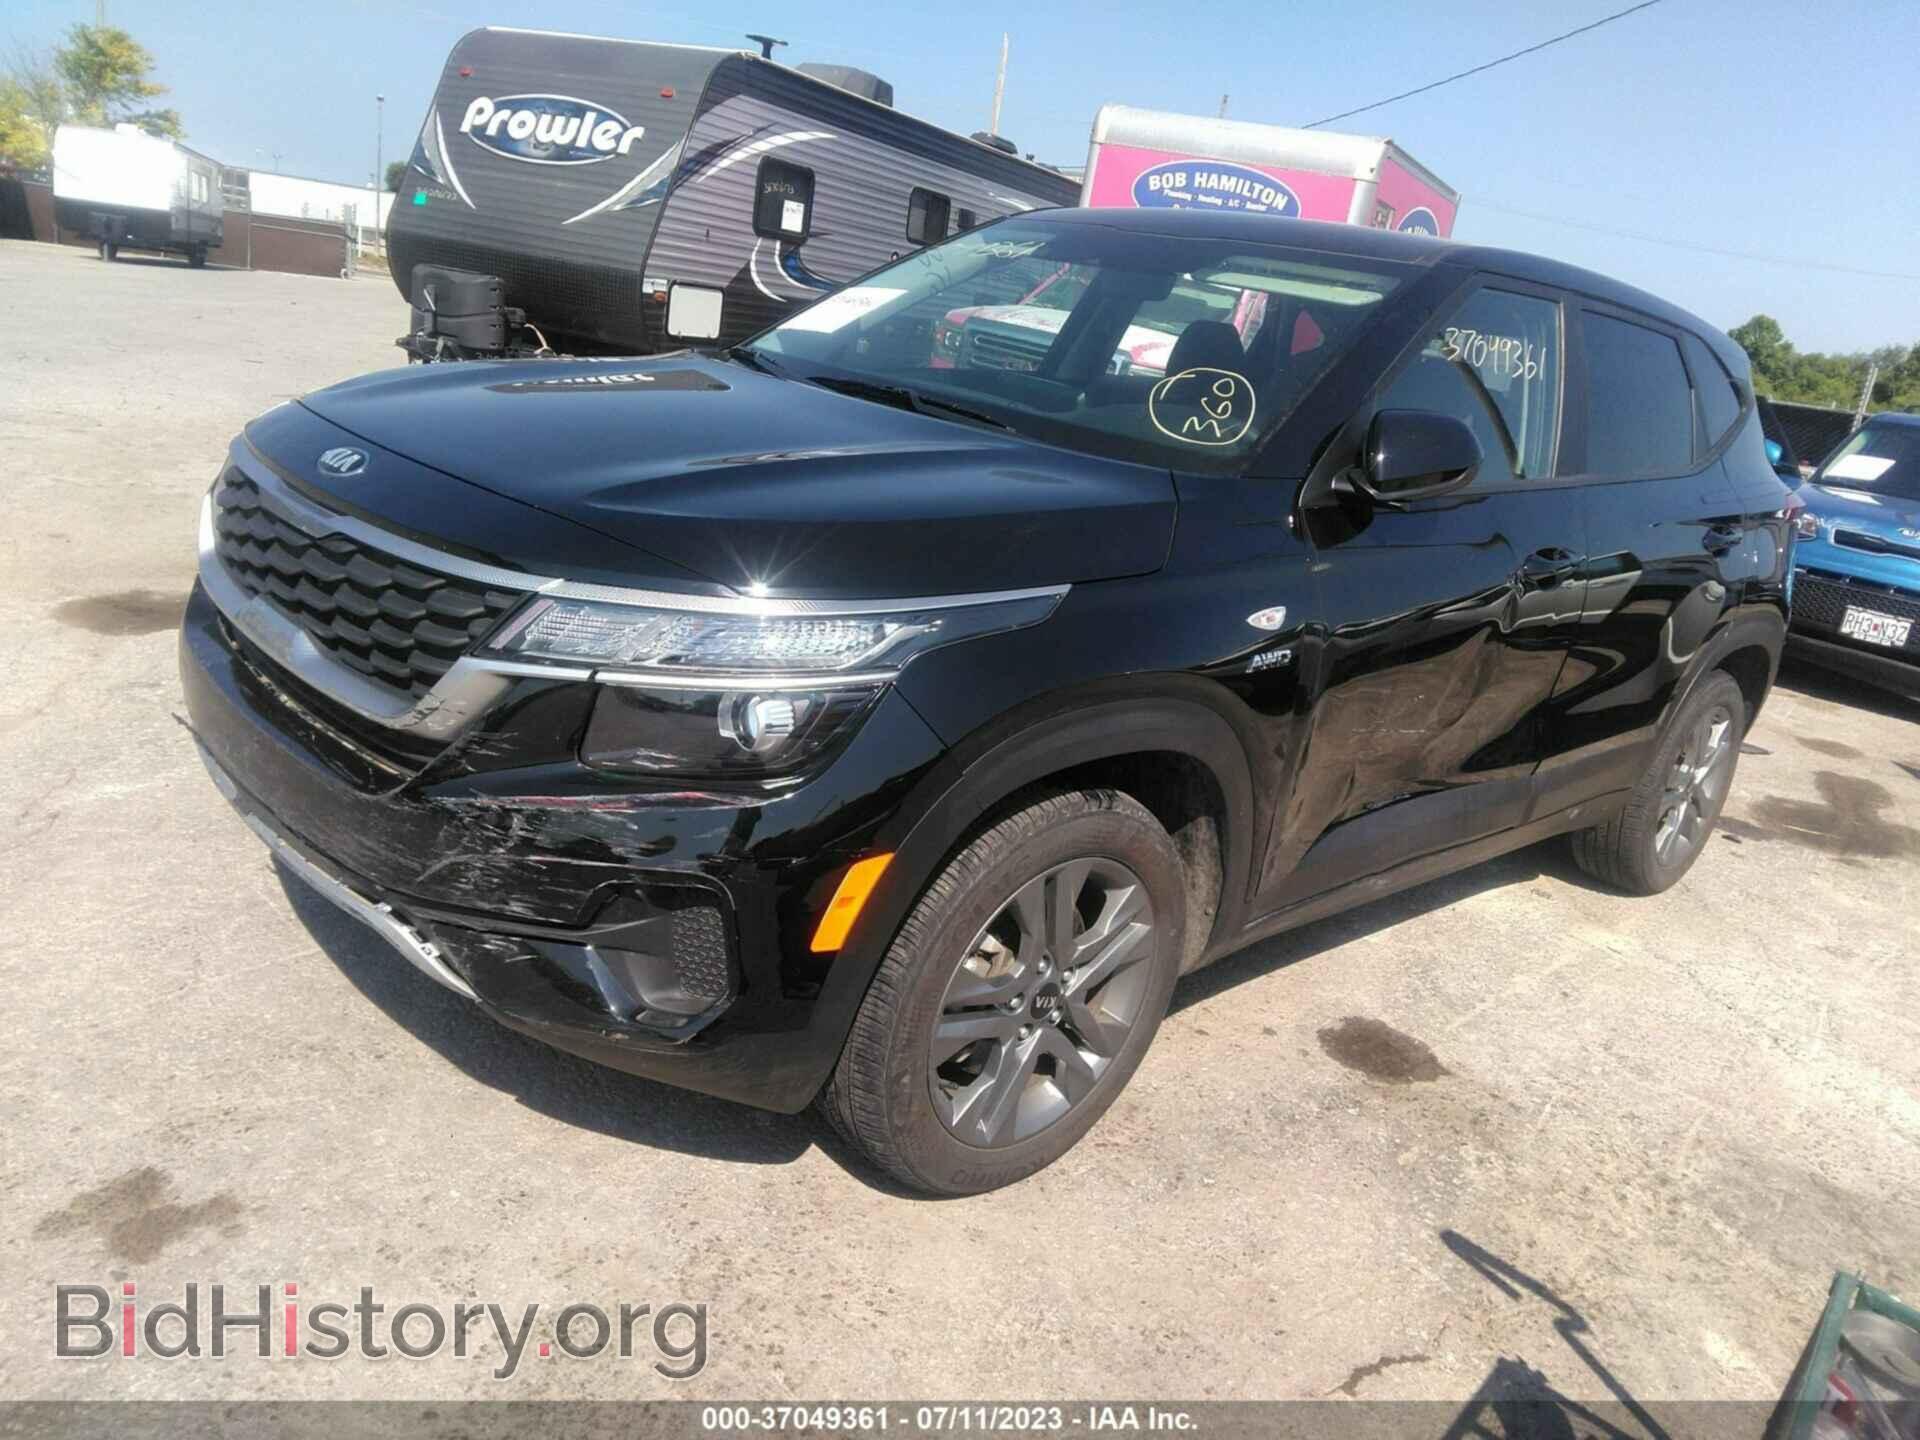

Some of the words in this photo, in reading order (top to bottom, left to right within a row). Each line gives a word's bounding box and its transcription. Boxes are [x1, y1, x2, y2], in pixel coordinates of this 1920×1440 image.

[459, 96, 645, 155] Prowler
[1148, 172, 1187, 191] BOB
[1193, 172, 1288, 211] HAMILTON
[1442, 327, 1547, 381] 37049361
[1245, 649, 1292, 673] AWD
